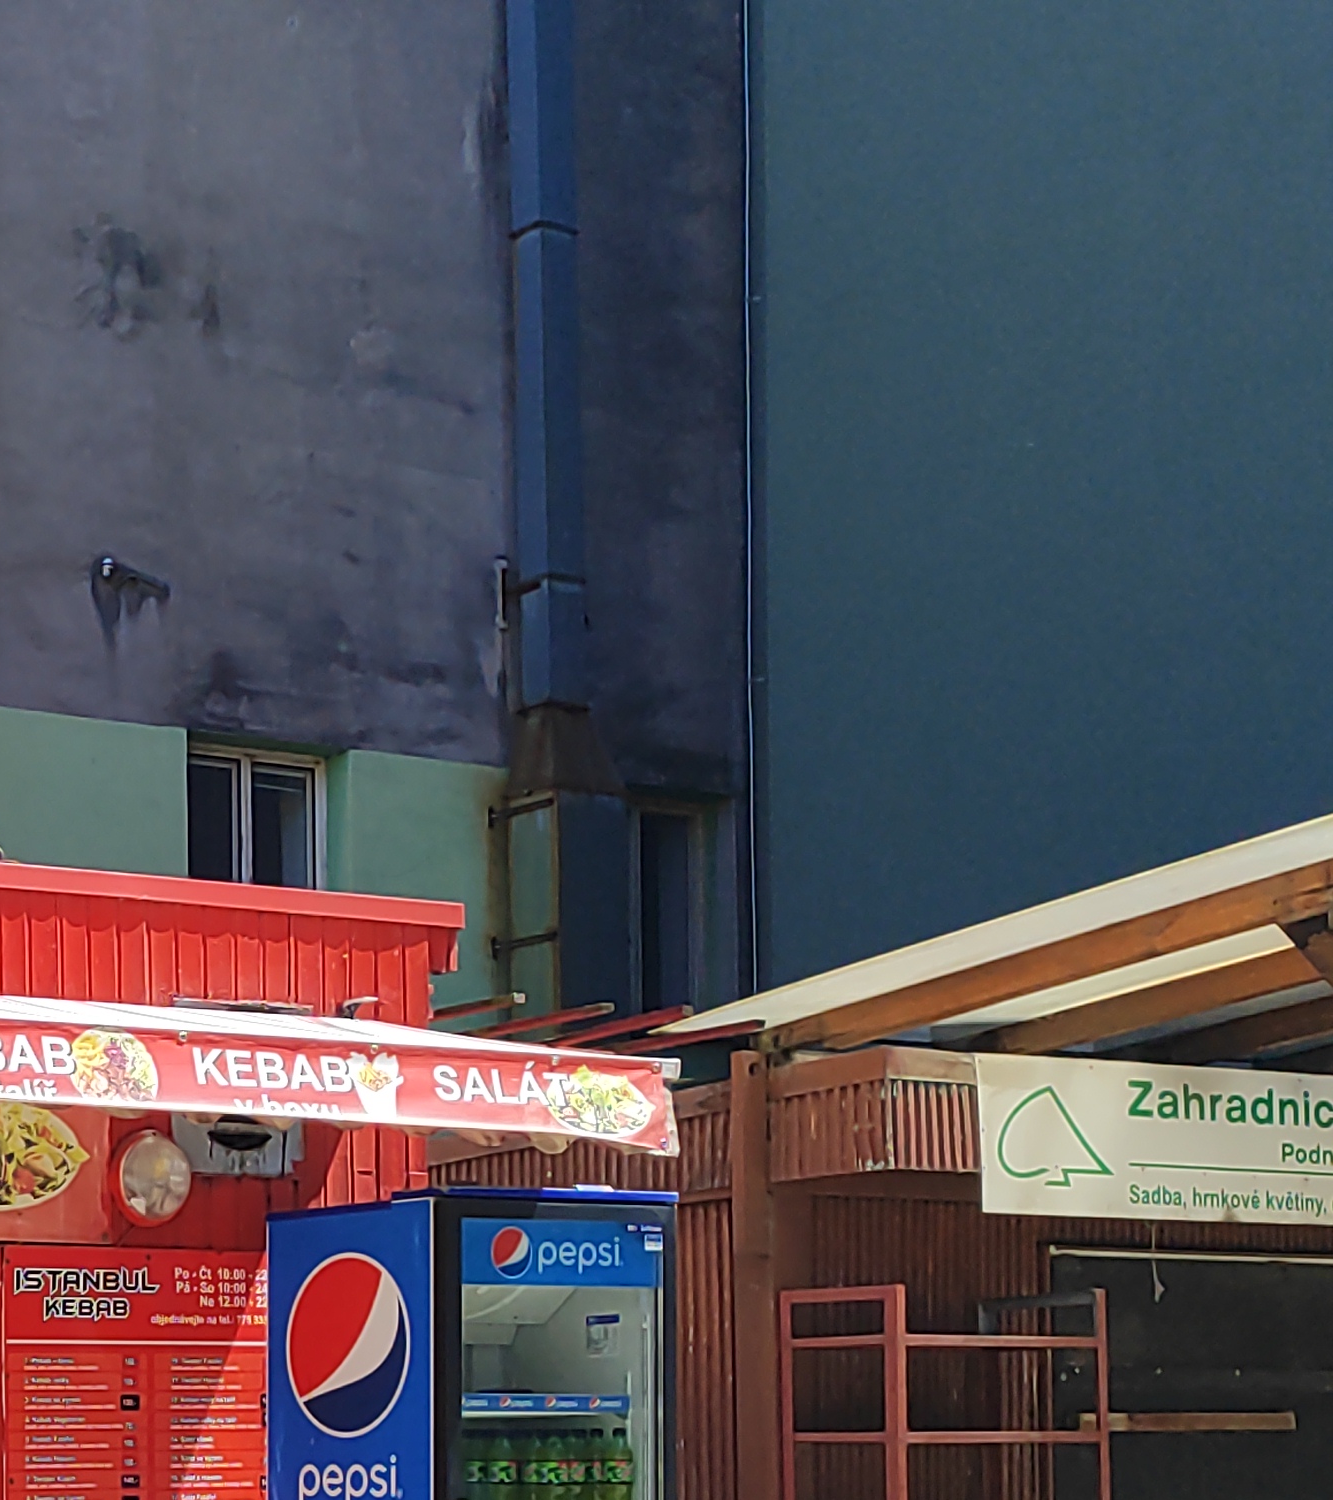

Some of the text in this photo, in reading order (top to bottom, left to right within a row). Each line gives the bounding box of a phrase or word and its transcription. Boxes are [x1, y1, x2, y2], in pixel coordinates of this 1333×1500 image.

[191, 1047, 354, 1093] KEBAB
[433, 1060, 569, 1107] SALÁT
[1129, 1184, 1328, 1216] Sadba, hrnkové květiny,
[539, 1236, 621, 1275] pepsi
[13, 1266, 162, 1297] ISTANBUL
[42, 1296, 131, 1322] KEBAB
